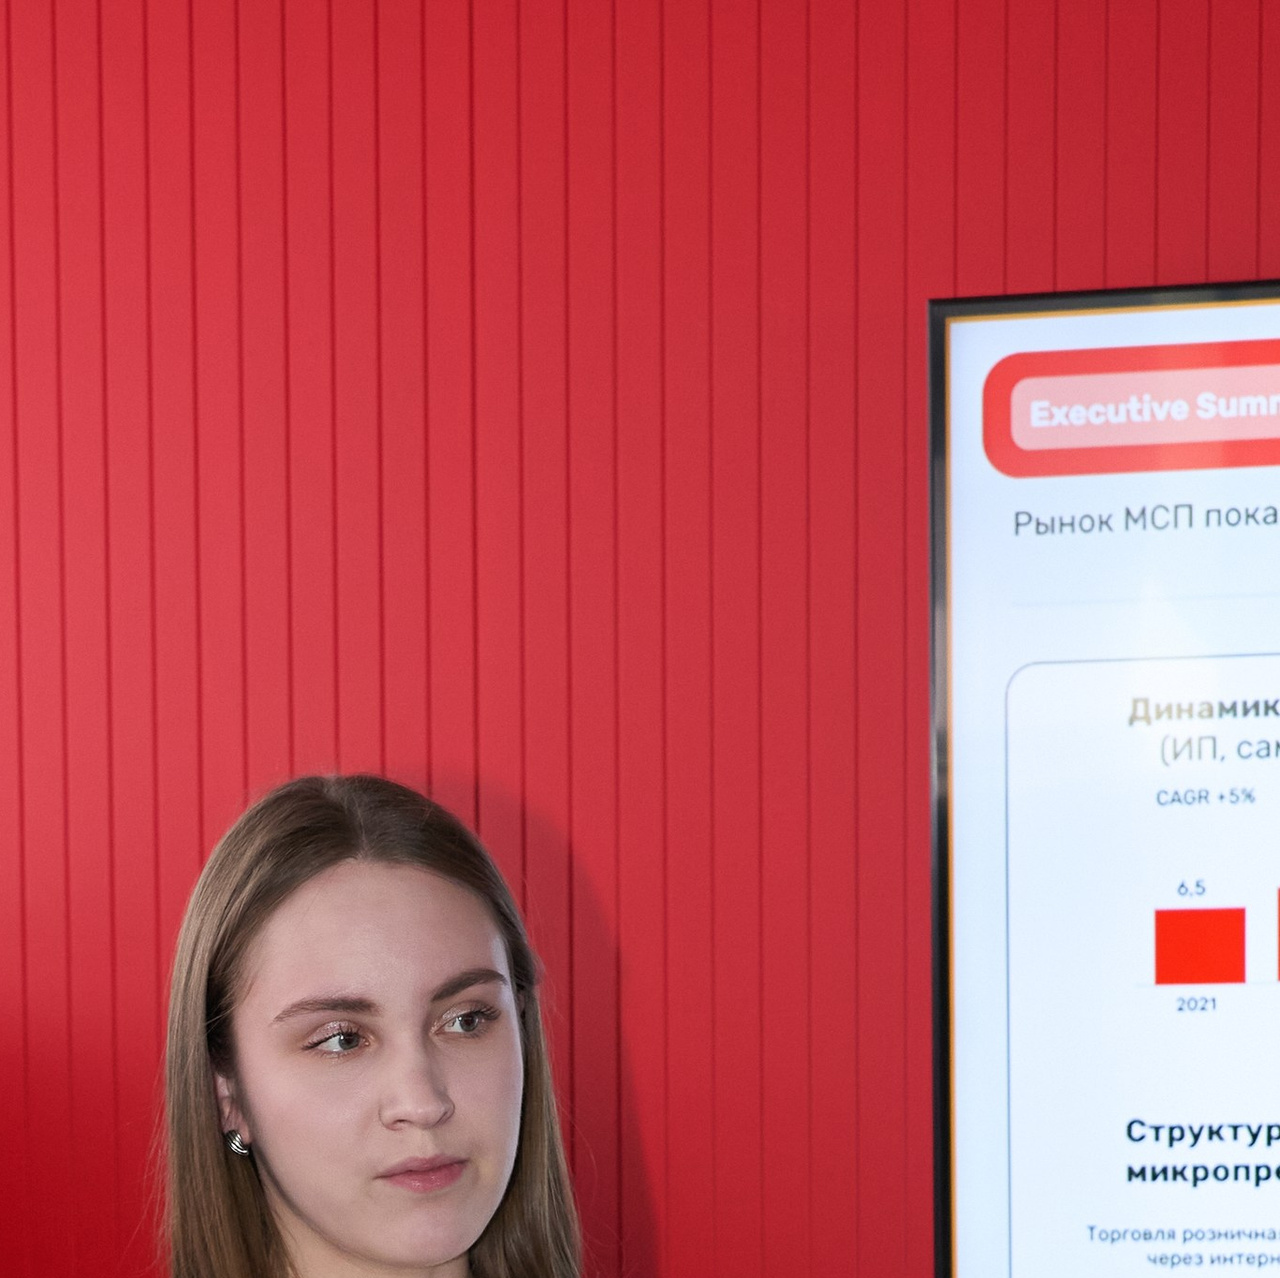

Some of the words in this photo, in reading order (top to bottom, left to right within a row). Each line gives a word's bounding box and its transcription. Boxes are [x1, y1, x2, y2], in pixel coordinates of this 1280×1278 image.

[1030, 393, 1190, 428] Executive
[1014, 511, 1113, 536] Рынок
[1124, 503, 1193, 532] МСП
[1205, 505, 1278, 528] пока
[1127, 697, 1280, 728] Динамик
[1160, 735, 1226, 767] (ИП,
[1236, 739, 1280, 760] са
[1156, 789, 1210, 807] CAGR
[1218, 788, 1256, 805] +5%
[1177, 996, 1217, 1012] 2021
[1126, 1118, 1280, 1149] Структур
[1087, 1225, 1176, 1245] Торговля
[1182, 1228, 1280, 1245] рознична
[1146, 1253, 1204, 1269] через
